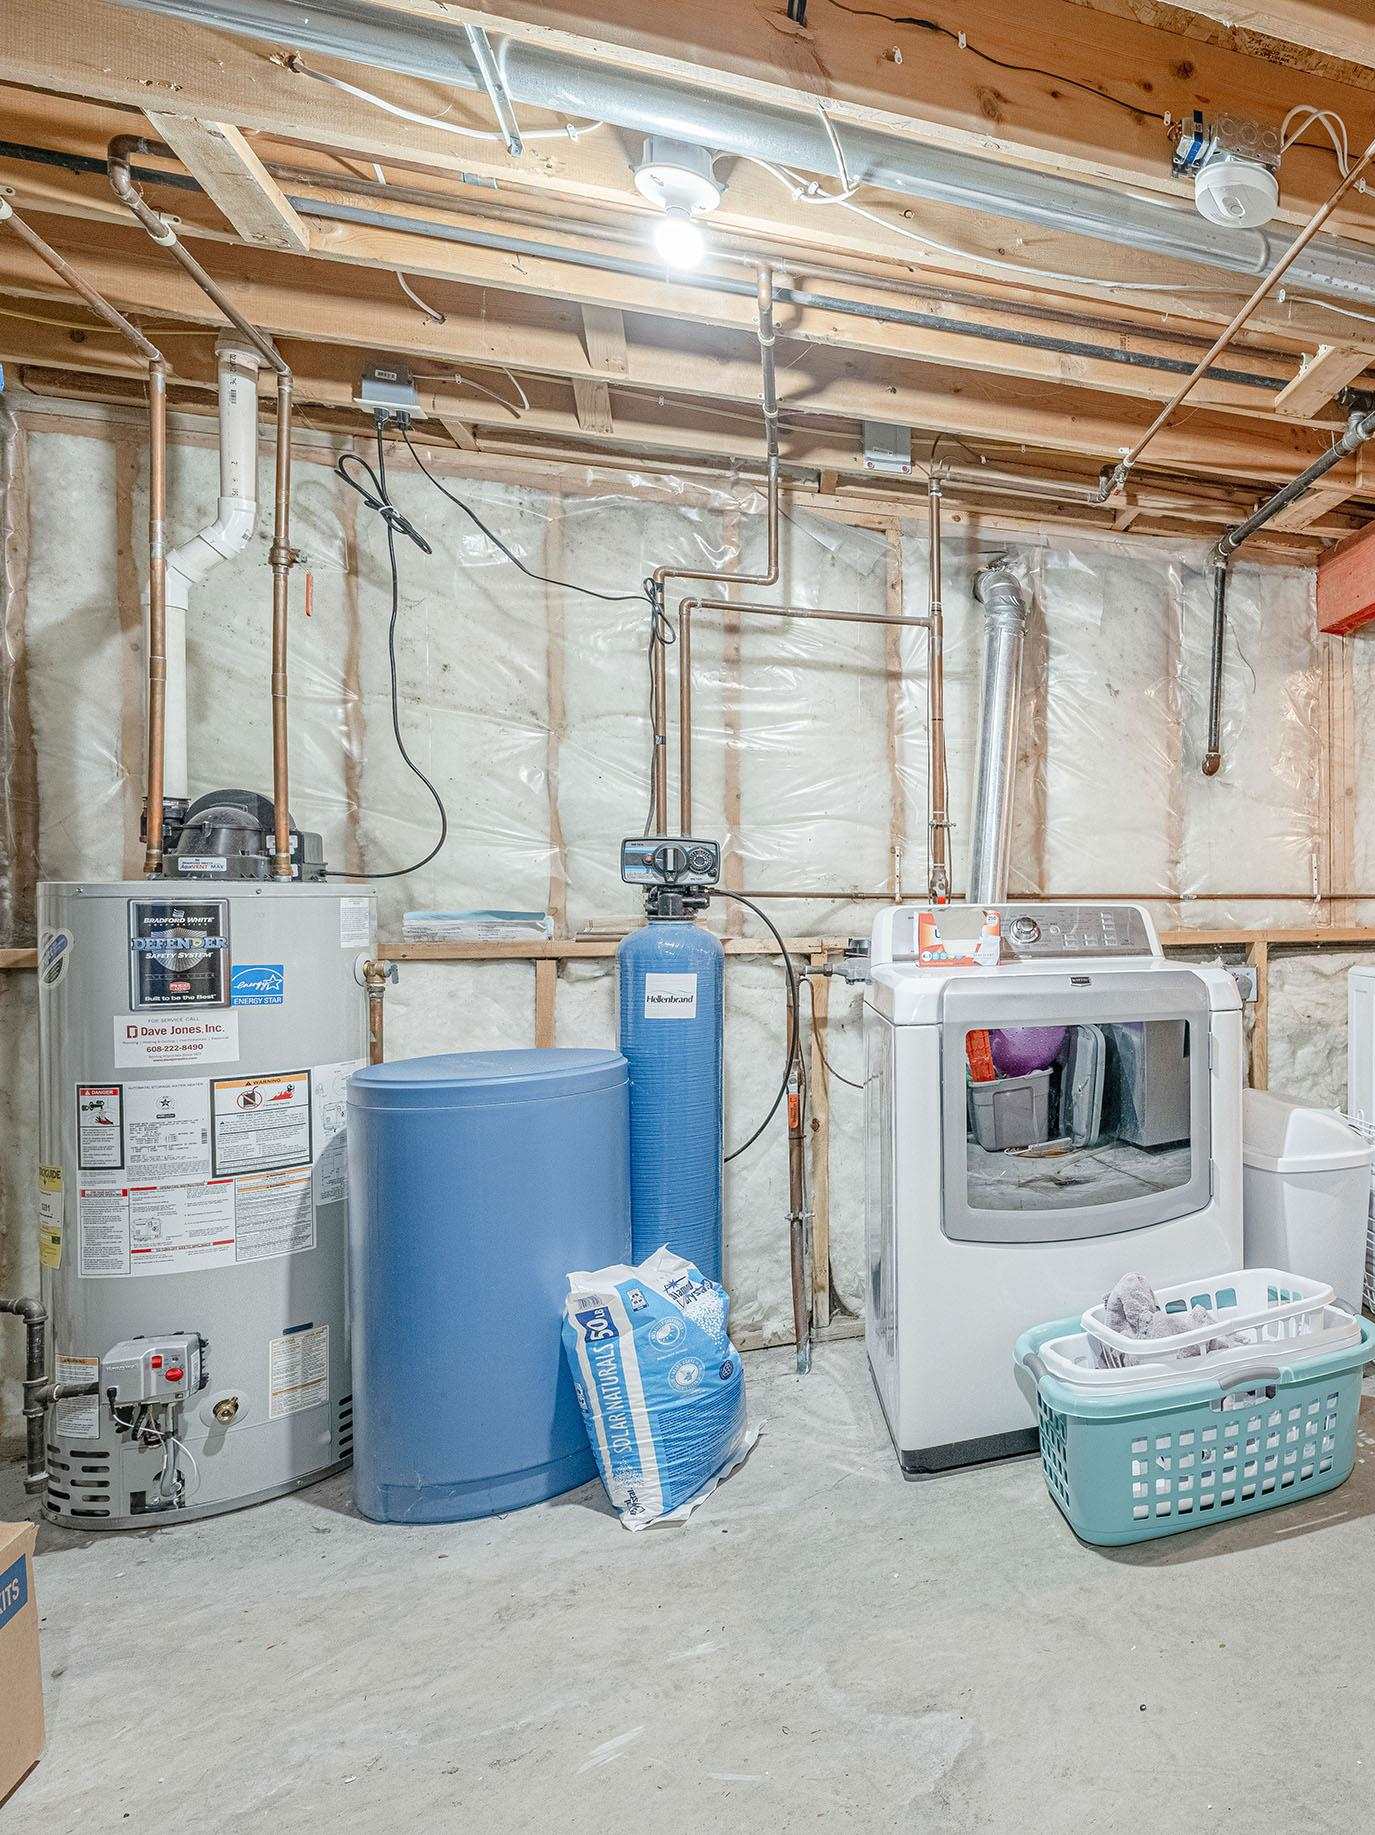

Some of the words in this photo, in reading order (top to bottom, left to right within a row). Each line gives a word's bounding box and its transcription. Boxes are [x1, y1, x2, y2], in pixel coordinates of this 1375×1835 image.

[132, 937, 227, 951] DEFENDER
[178, 951, 212, 959] SYSTEM
[233, 997, 263, 1005] ENERGY
[646, 994, 694, 1004] Hellenbrand
[140, 1026, 167, 1036] Dave
[205, 1024, 225, 1033] Inc.
[146, 1043, 204, 1053] 608-222-8490
[587, 1317, 614, 1342] 50
[593, 1342, 625, 1412] NATURALS
[609, 1413, 632, 1453] SOLAR
